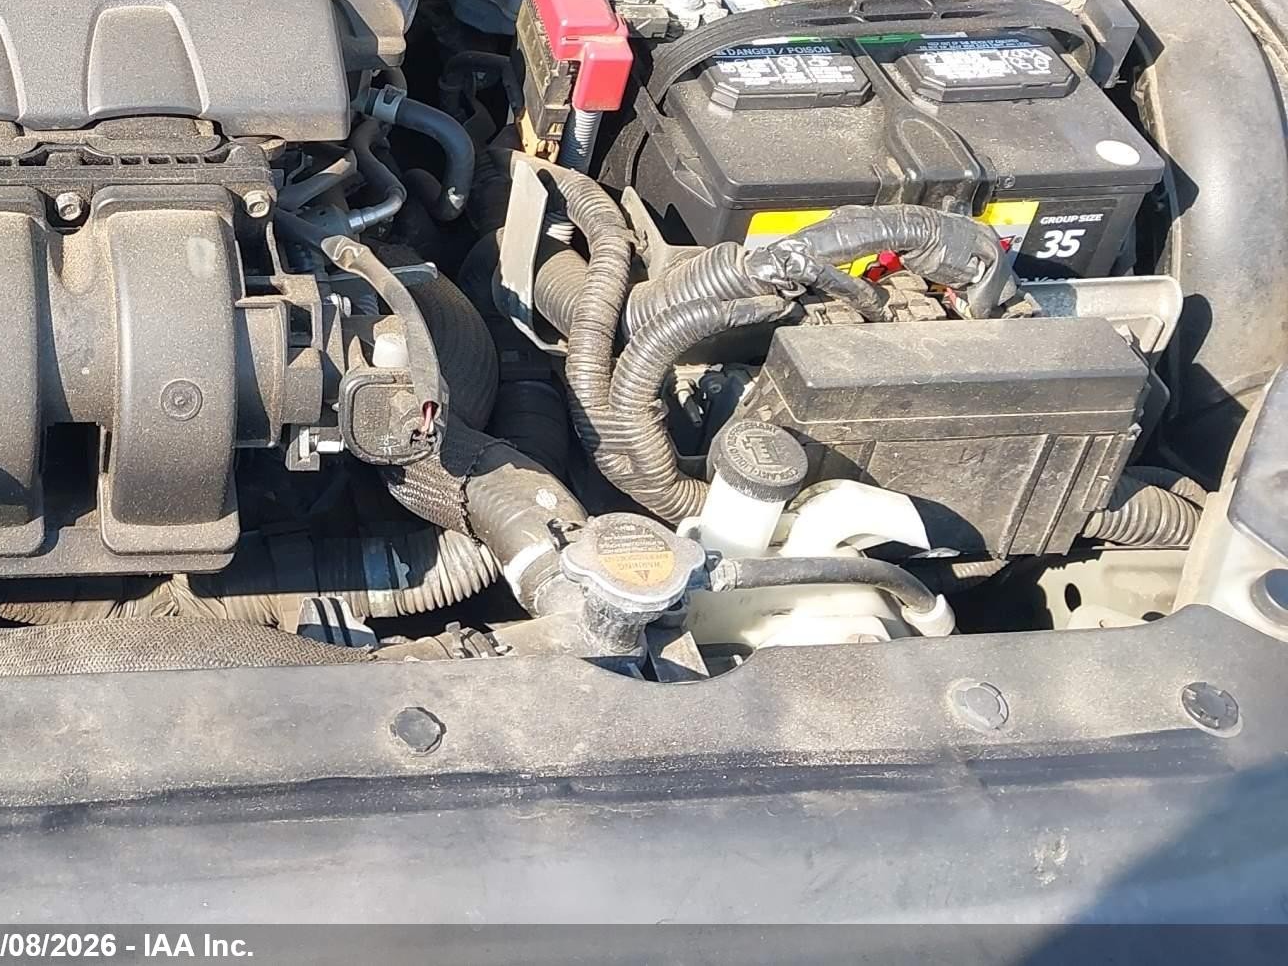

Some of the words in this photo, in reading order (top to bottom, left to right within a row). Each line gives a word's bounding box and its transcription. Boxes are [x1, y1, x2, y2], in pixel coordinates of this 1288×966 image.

[727, 47, 777, 56] DANGER
[788, 45, 832, 55] POISON
[1040, 215, 1079, 225] GROUP
[1078, 213, 1104, 223] SIZE
[1036, 229, 1086, 259] 35
